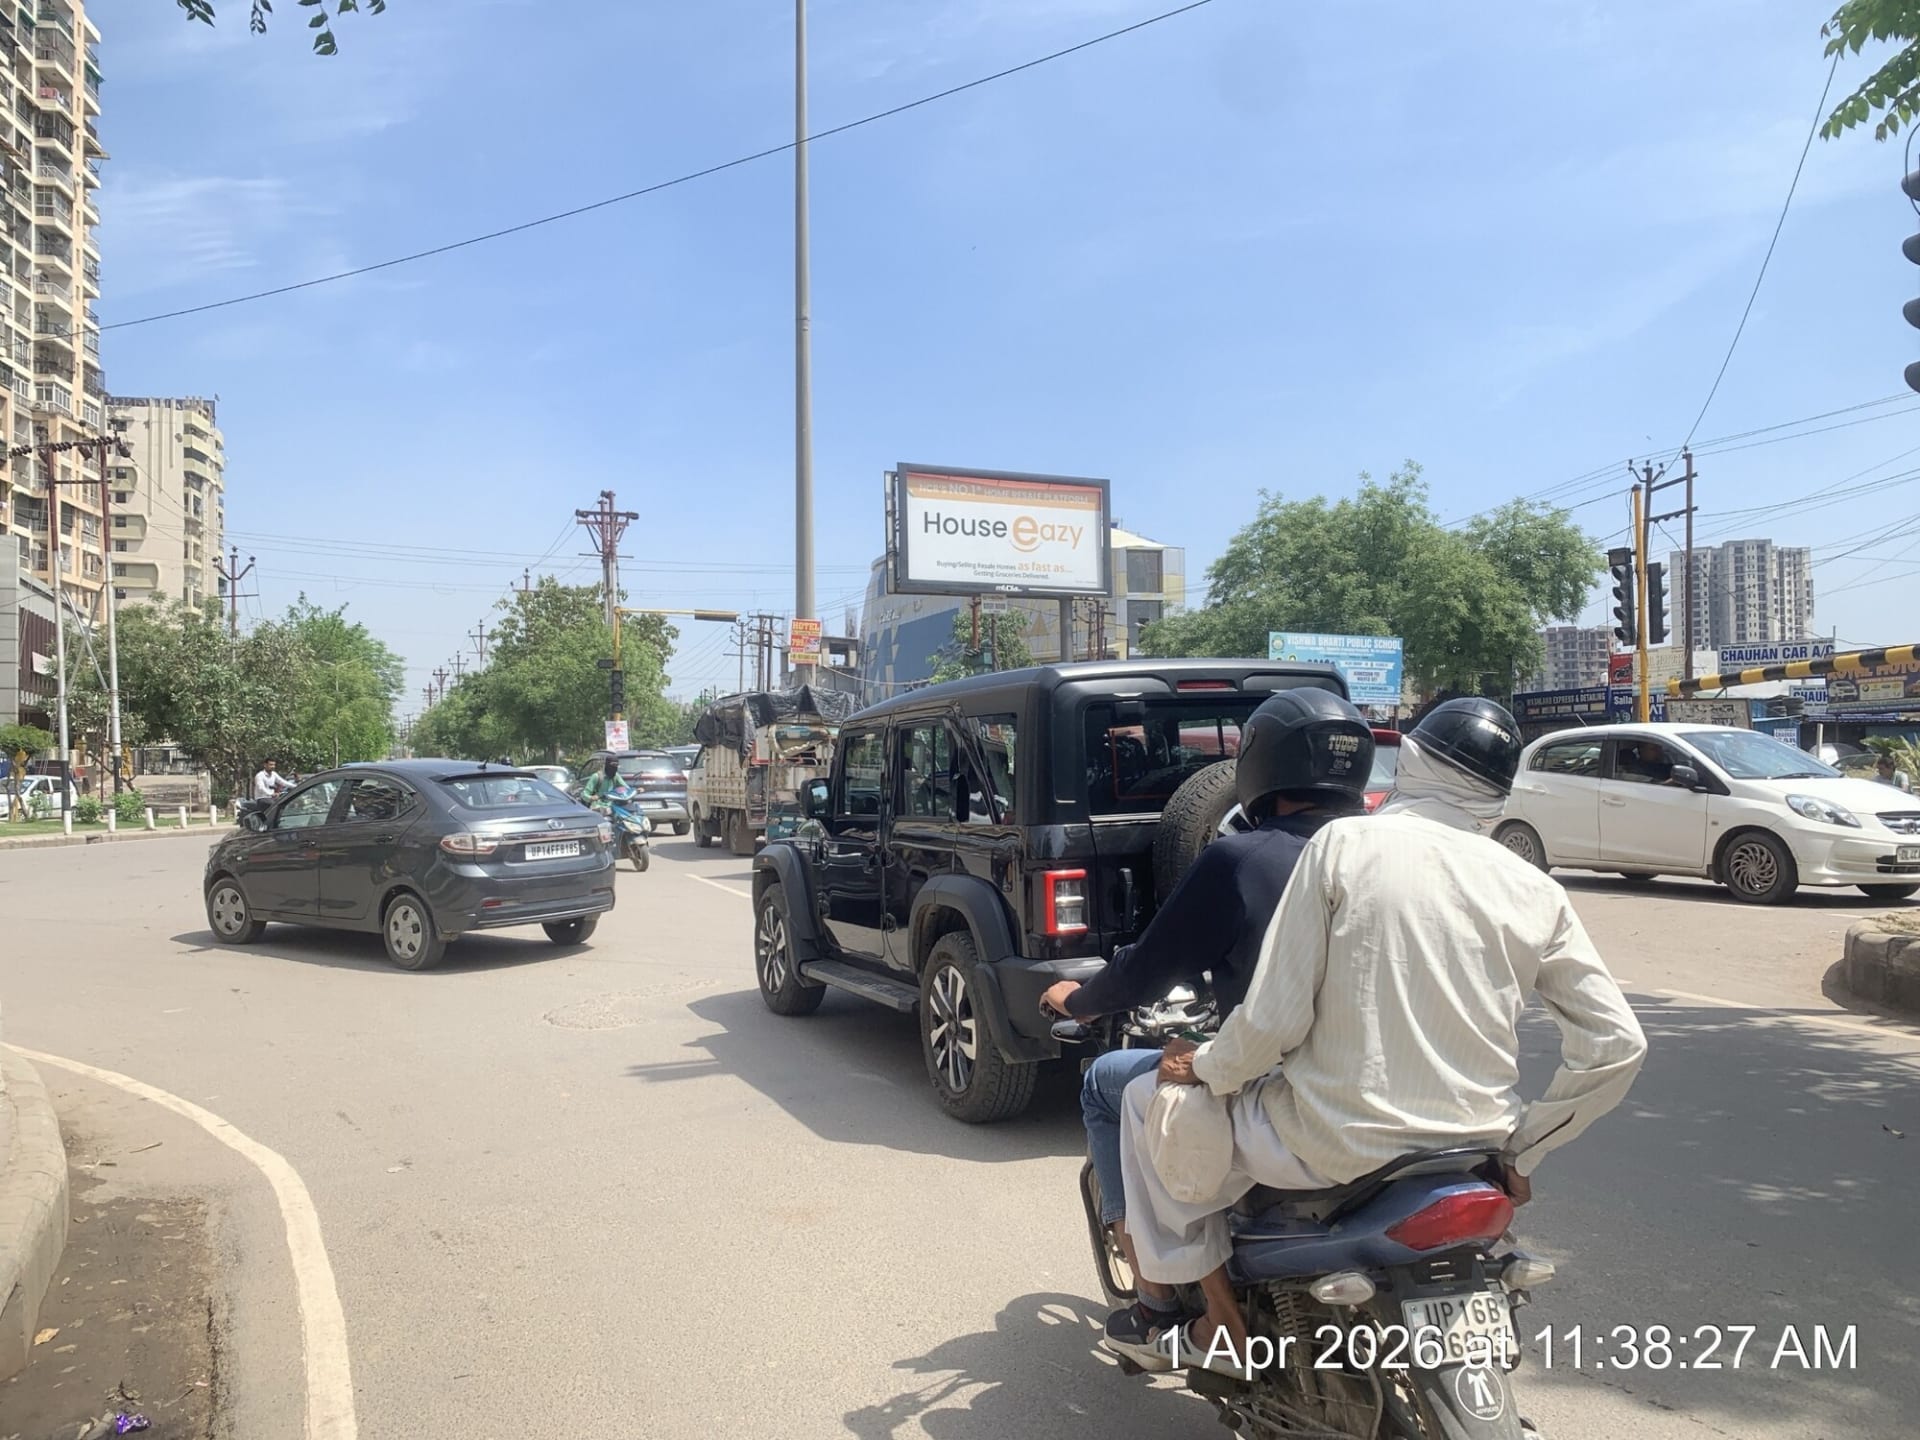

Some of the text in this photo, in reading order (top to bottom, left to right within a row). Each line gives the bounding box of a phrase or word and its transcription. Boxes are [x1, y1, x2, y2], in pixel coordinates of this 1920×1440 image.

[923, 511, 1008, 538] House
[1018, 562, 1030, 572] as
[1031, 562, 1051, 573] fast
[1347, 637, 1372, 649] PUBLIC
[1374, 638, 1402, 650] SCHOOL
[1720, 648, 1778, 662] CHAUHAN
[1782, 646, 1808, 660] CAR
[1812, 644, 1835, 659] A/C
[1553, 694, 1575, 704] EXPRESS
